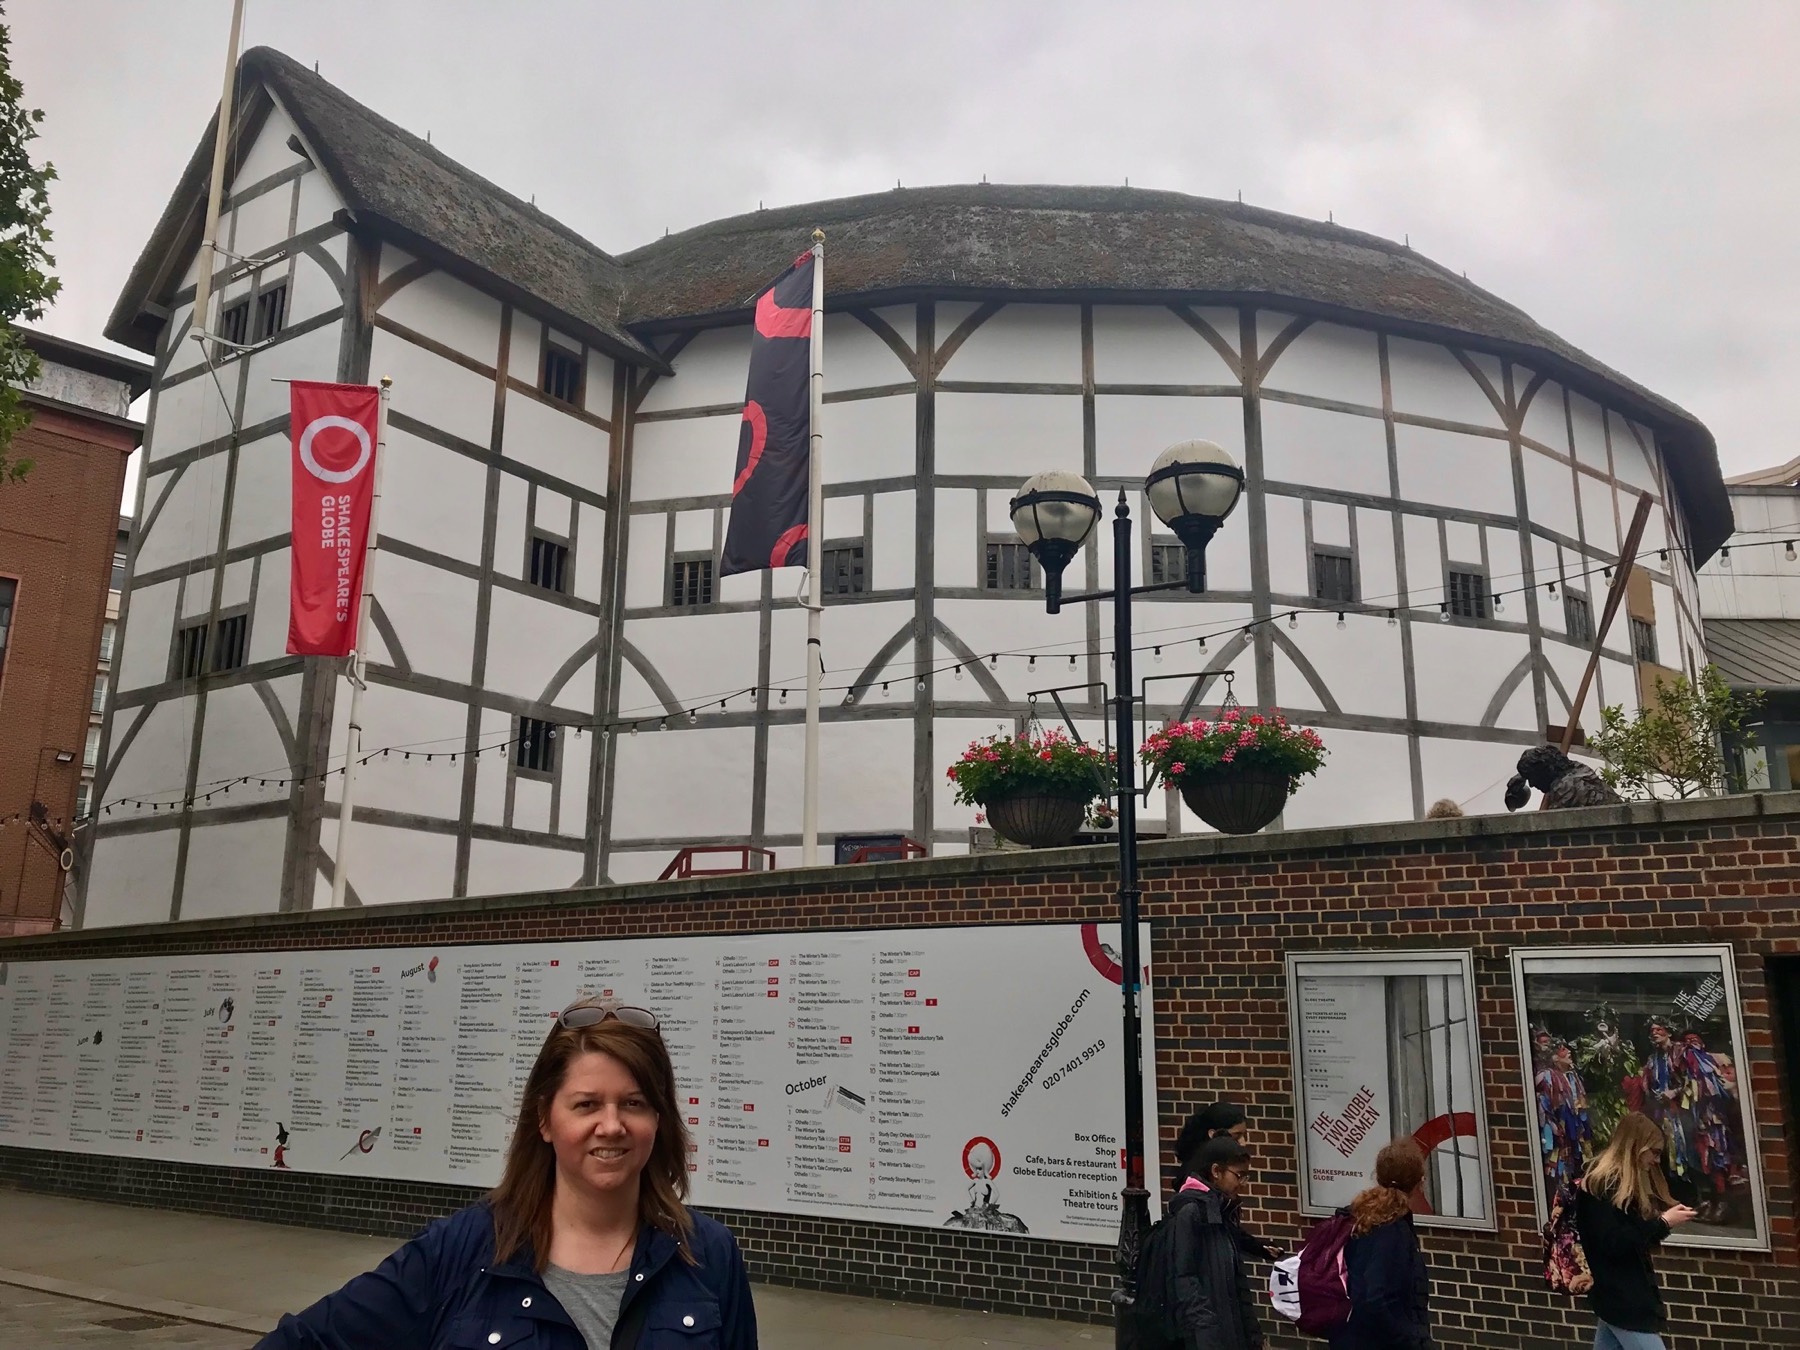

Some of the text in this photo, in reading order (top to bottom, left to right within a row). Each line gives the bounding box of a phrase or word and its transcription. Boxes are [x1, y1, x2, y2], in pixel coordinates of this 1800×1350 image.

[321, 495, 336, 549] GLOBE
[336, 494, 350, 622] SHAKESPEARE'S
[401, 962, 424, 979] August
[1672, 990, 1691, 1007] THE
[1683, 973, 1721, 1014] TWO NOBLE
[1694, 985, 1724, 1022] KINSMEN
[203, 1008, 215, 1018] July
[76, 1036, 89, 1046] June
[1001, 989, 1090, 1117] shakespearesglobe.com
[1042, 1039, 1106, 1090] 020 7401 9919
[785, 1074, 827, 1095] October
[1310, 1110, 1334, 1136] THE
[1323, 1120, 1348, 1147] TWO
[1341, 1085, 1375, 1124] NOBLE
[1075, 1133, 1116, 1143] Box Office
[1337, 1106, 1380, 1158] KINSMEN
[1095, 1147, 1116, 1157] Shop
[1026, 1155, 1117, 1169] Cafe, bars & restaurant
[1013, 1167, 1117, 1182] Globe Education reception
[1313, 1169, 1363, 1177] SHAKESPEARE'S
[1069, 1189, 1118, 1200] Exhibition &
[1063, 1199, 1118, 1211] Theatre tours
